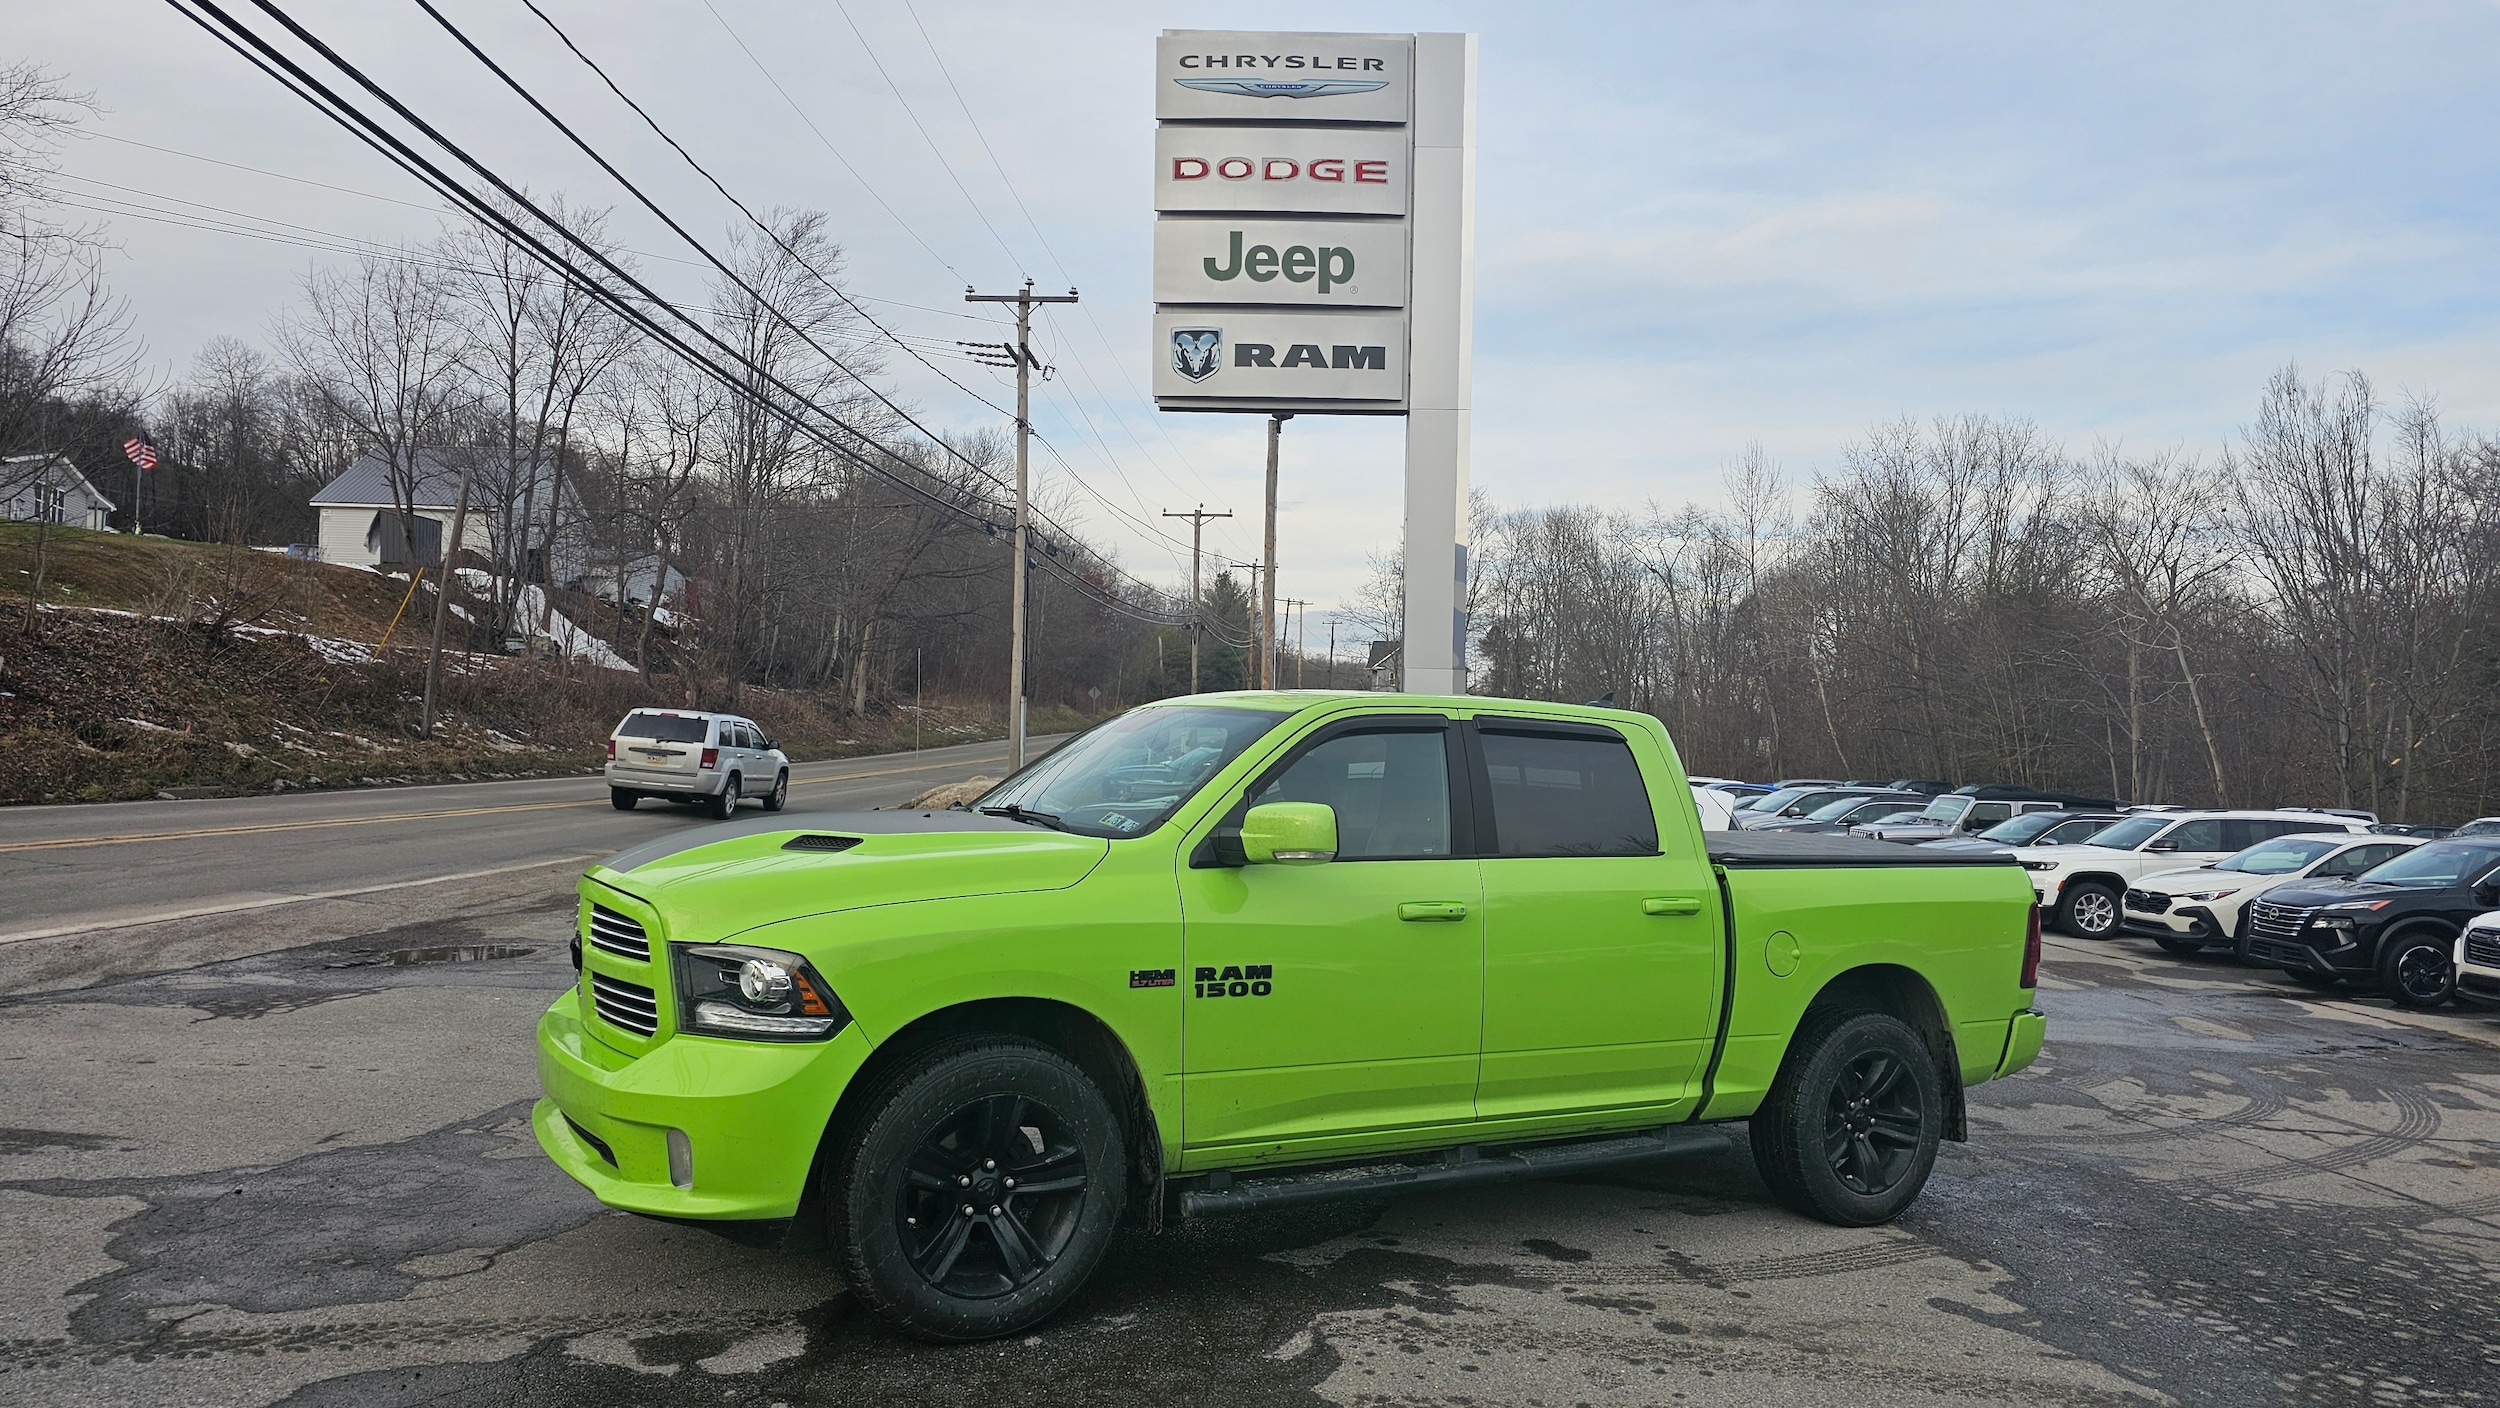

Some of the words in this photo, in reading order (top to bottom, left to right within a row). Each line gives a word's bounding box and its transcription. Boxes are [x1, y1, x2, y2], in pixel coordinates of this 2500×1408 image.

[1179, 54, 1385, 71] CHRYSLER
[1172, 156, 1389, 185] DODGE
[1203, 231, 1355, 294] Jeep
[1234, 343, 1386, 370] RAM
[1130, 969, 1175, 980] HEMI
[1195, 965, 1272, 982] RAM
[1195, 981, 1272, 998] 1500
